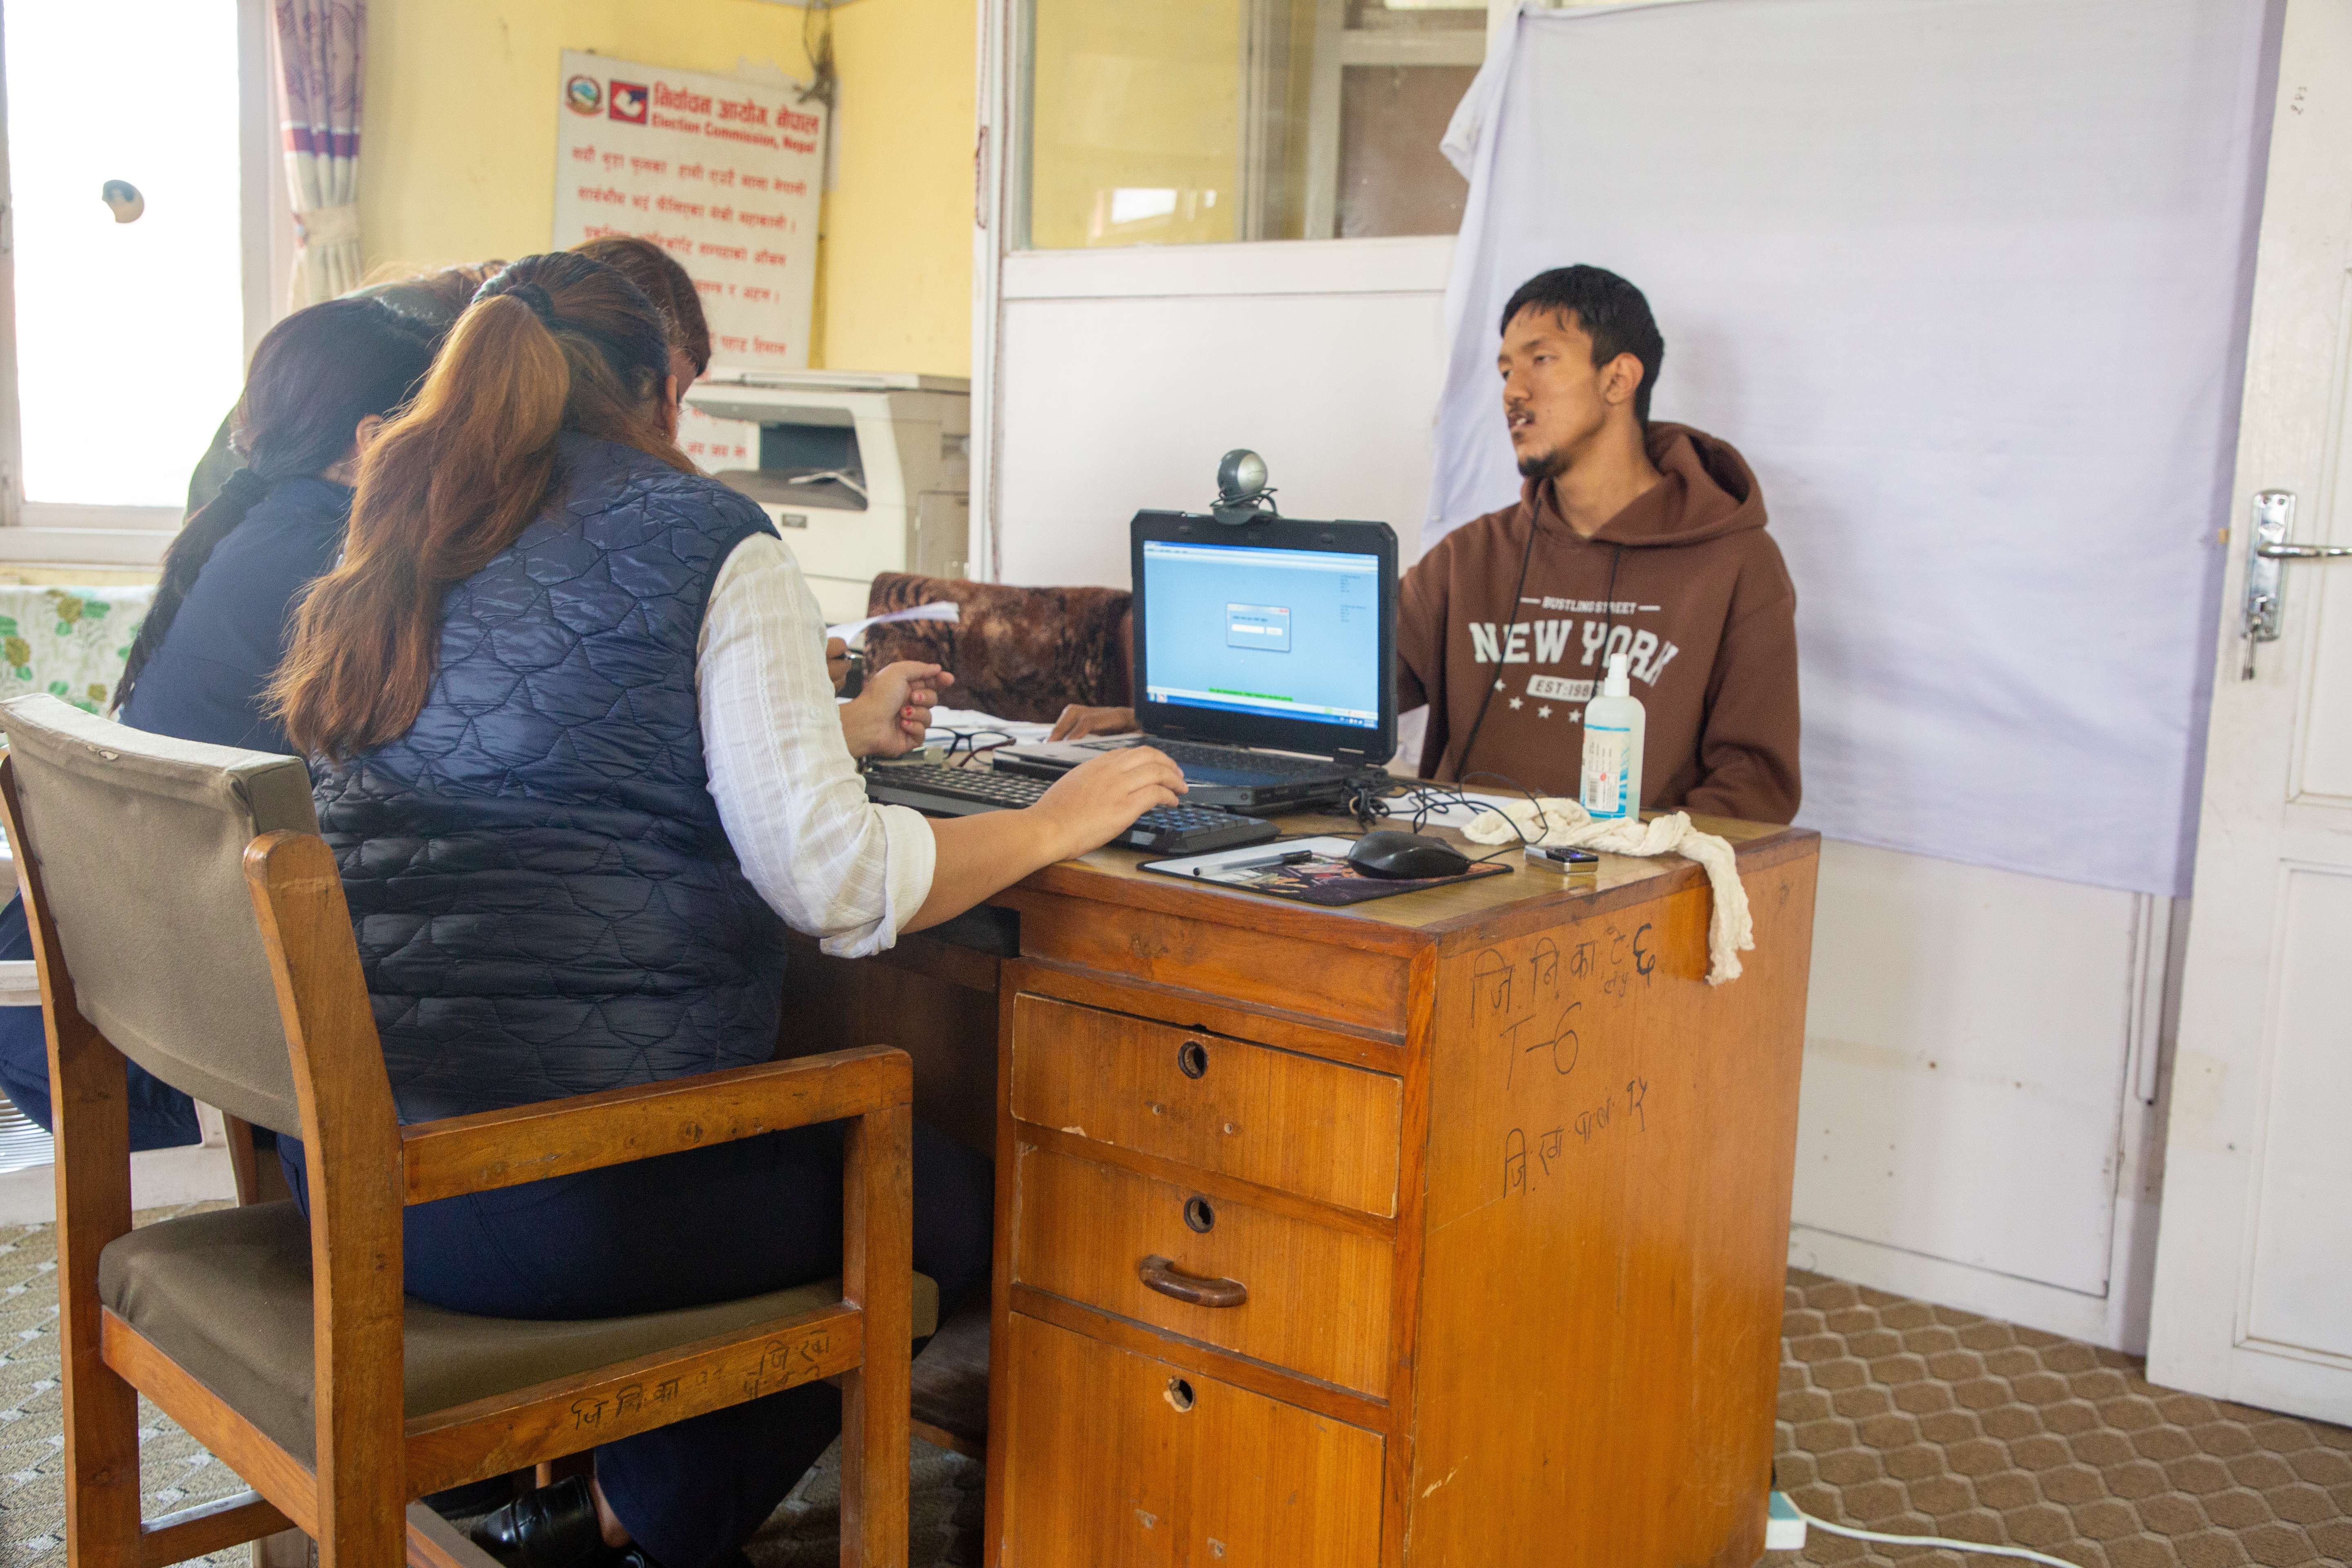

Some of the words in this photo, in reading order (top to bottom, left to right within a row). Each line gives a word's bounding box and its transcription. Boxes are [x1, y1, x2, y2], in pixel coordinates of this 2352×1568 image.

[651, 112, 701, 134] Election
[704, 120, 779, 150] Commission,
[782, 136, 815, 154] Nepal
[776, 105, 819, 135] नेपाल
[1469, 619, 1572, 664] NEW
[1581, 620, 1679, 688] YORK
